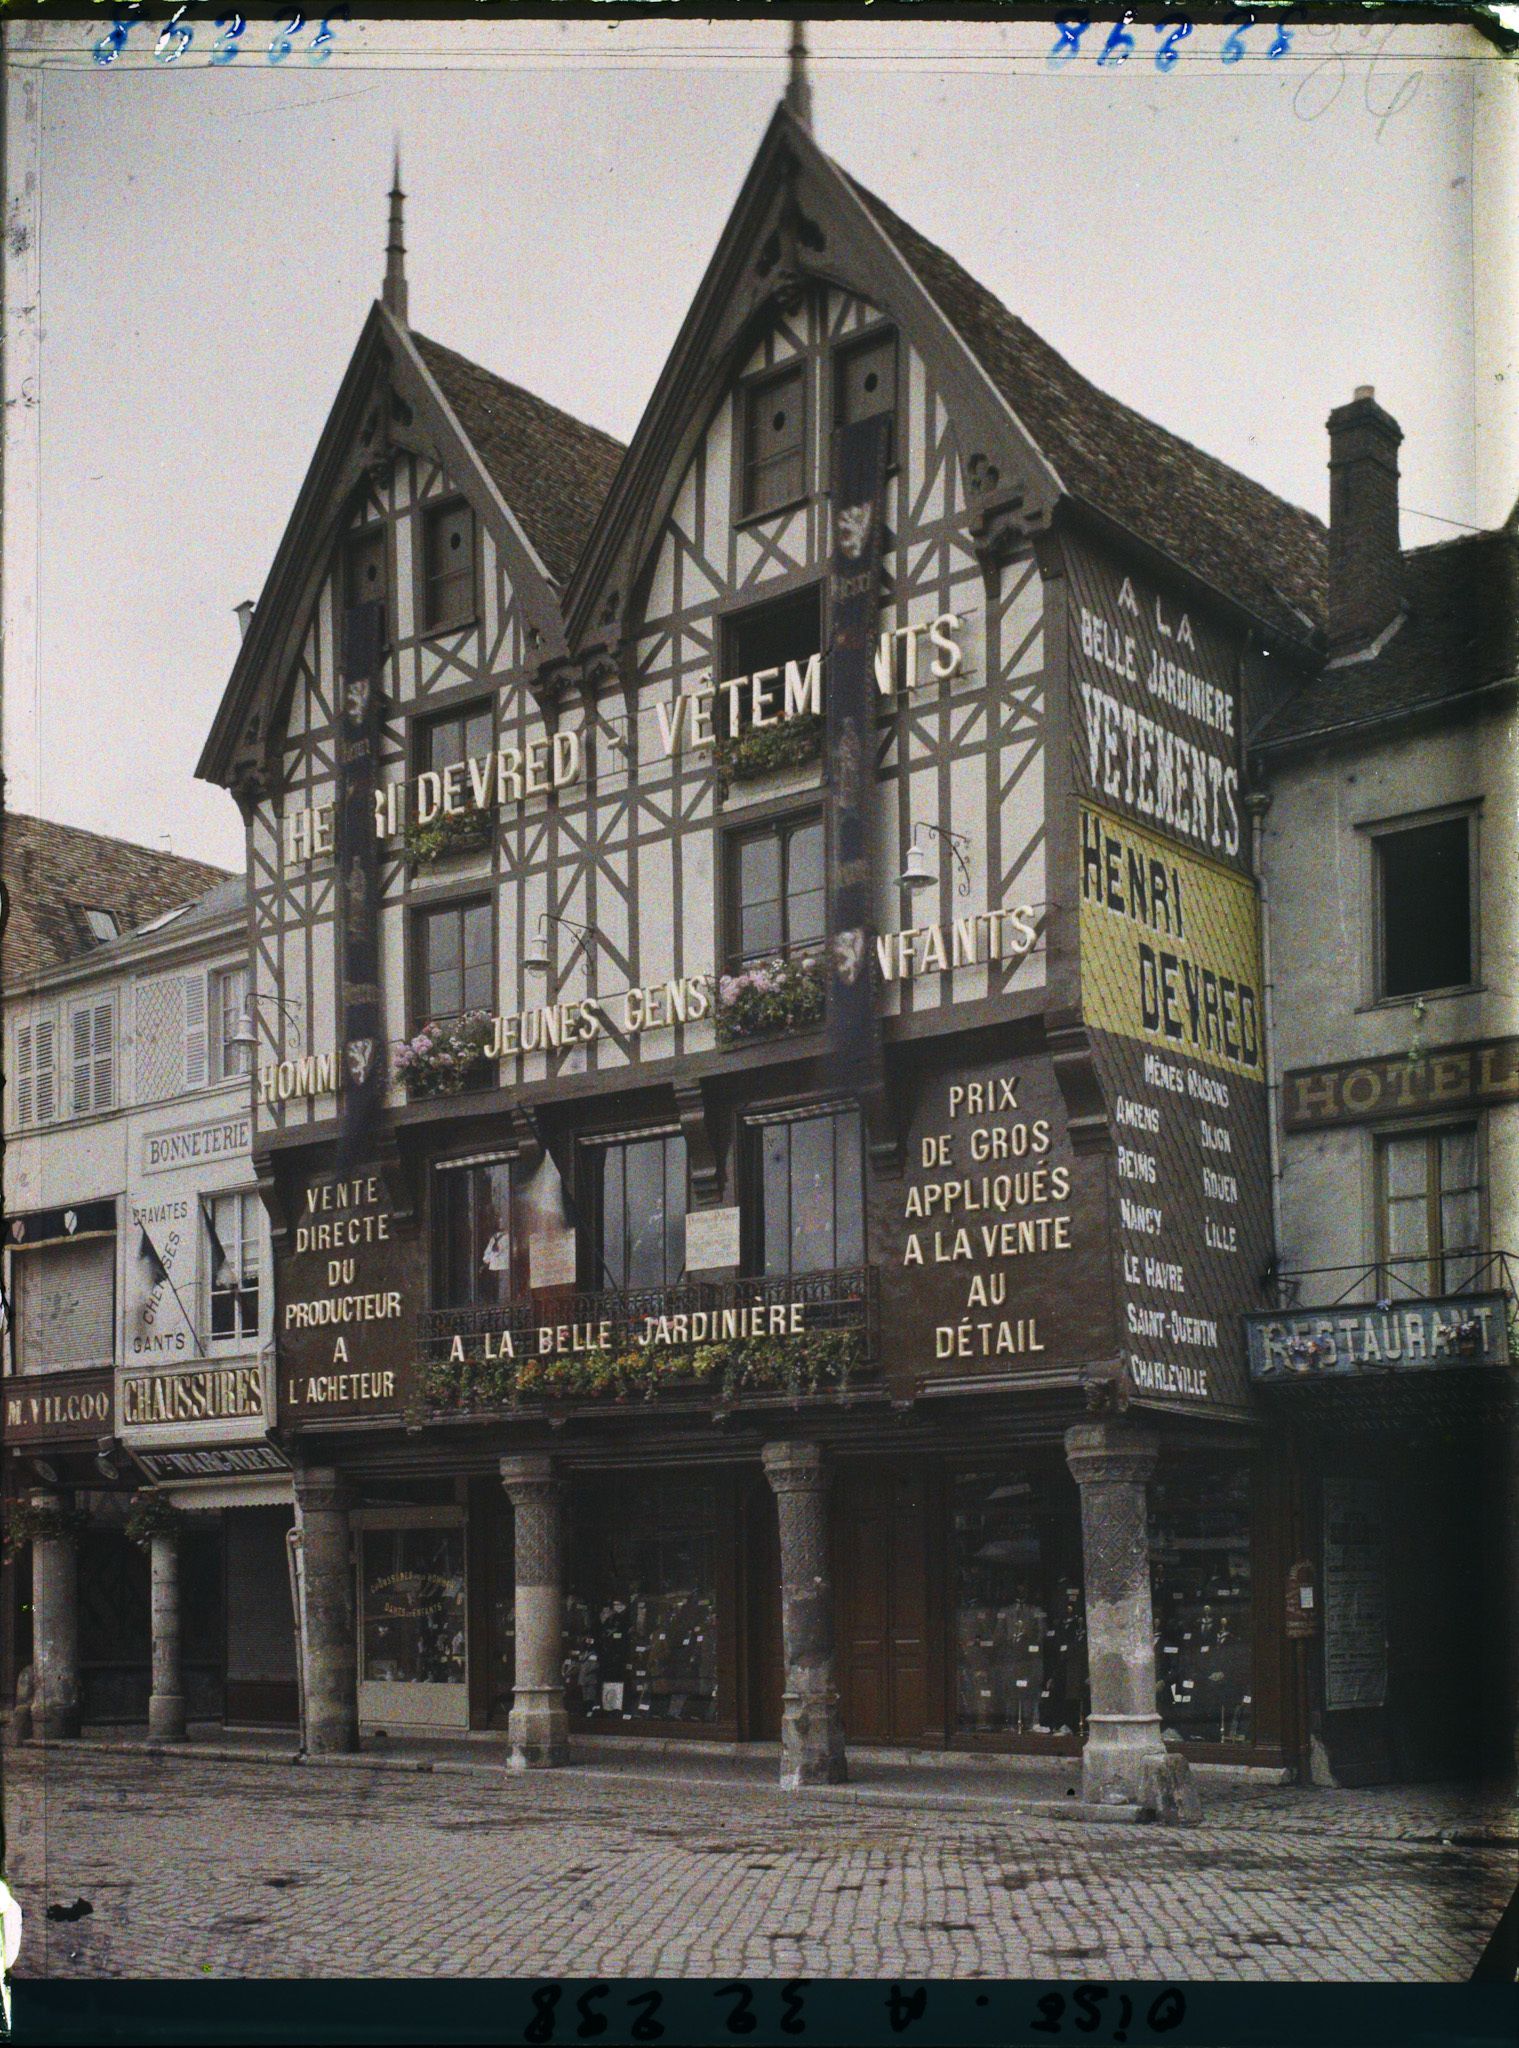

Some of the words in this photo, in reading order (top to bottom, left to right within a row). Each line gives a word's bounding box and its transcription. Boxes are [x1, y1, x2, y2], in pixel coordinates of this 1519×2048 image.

[1118, 576, 1139, 617] A
[1156, 595, 1196, 652] LA
[1081, 607, 1137, 682] BELLE
[656, 613, 962, 757] VÊTEMNTS
[418, 730, 580, 826] DEVRED
[1083, 811, 1183, 939] HENRI
[876, 904, 1037, 982] NFANTS
[484, 998, 601, 1060] JEUNES
[624, 974, 709, 1033] GENS
[1139, 941, 1258, 1067] DEVRED
[950, 1077, 1018, 1117] PRIX
[1294, 1050, 1519, 1120] HOTEL
[1116, 1095, 1160, 1134] AMIENS
[1201, 1119, 1231, 1154] DIJON
[150, 1121, 249, 1165] BONNETERIE
[921, 1135, 953, 1168] DE
[970, 1120, 1050, 1161] GROS
[1118, 1145, 1157, 1185] REIMS
[306, 1177, 378, 1214] VENTE
[904, 1160, 1071, 1219] APPLIQUÉS
[1202, 1166, 1238, 1204] ROUEN
[296, 1214, 390, 1253] DIRECTE
[1120, 1198, 1162, 1236] NANCY
[1205, 1216, 1237, 1253] LILLE
[903, 1233, 924, 1266] A
[935, 1227, 973, 1263] LA
[981, 1216, 1072, 1258] VENTE
[143, 1231, 180, 1325] CHESES
[328, 1258, 356, 1288] DU
[966, 1271, 1007, 1308] AU
[1124, 1249, 1141, 1284] LE
[1145, 1256, 1185, 1293] HAVRE
[285, 1291, 402, 1330] PRODUCTEUR
[450, 1335, 465, 1363] A
[485, 1330, 515, 1360] LA
[539, 1320, 612, 1355] BELLE
[638, 1295, 806, 1346] JARDINIÈRE
[1127, 1302, 1218, 1349] SAINT-QUENTIN
[133, 1332, 186, 1354] GANTS
[333, 1336, 349, 1364] A
[935, 1316, 1046, 1359] DÉTAIL
[124, 1368, 263, 1423] CHAUSSURES
[289, 1371, 396, 1405] L'ACHETEUR
[1130, 1354, 1208, 1396] CHARLEVILLE
